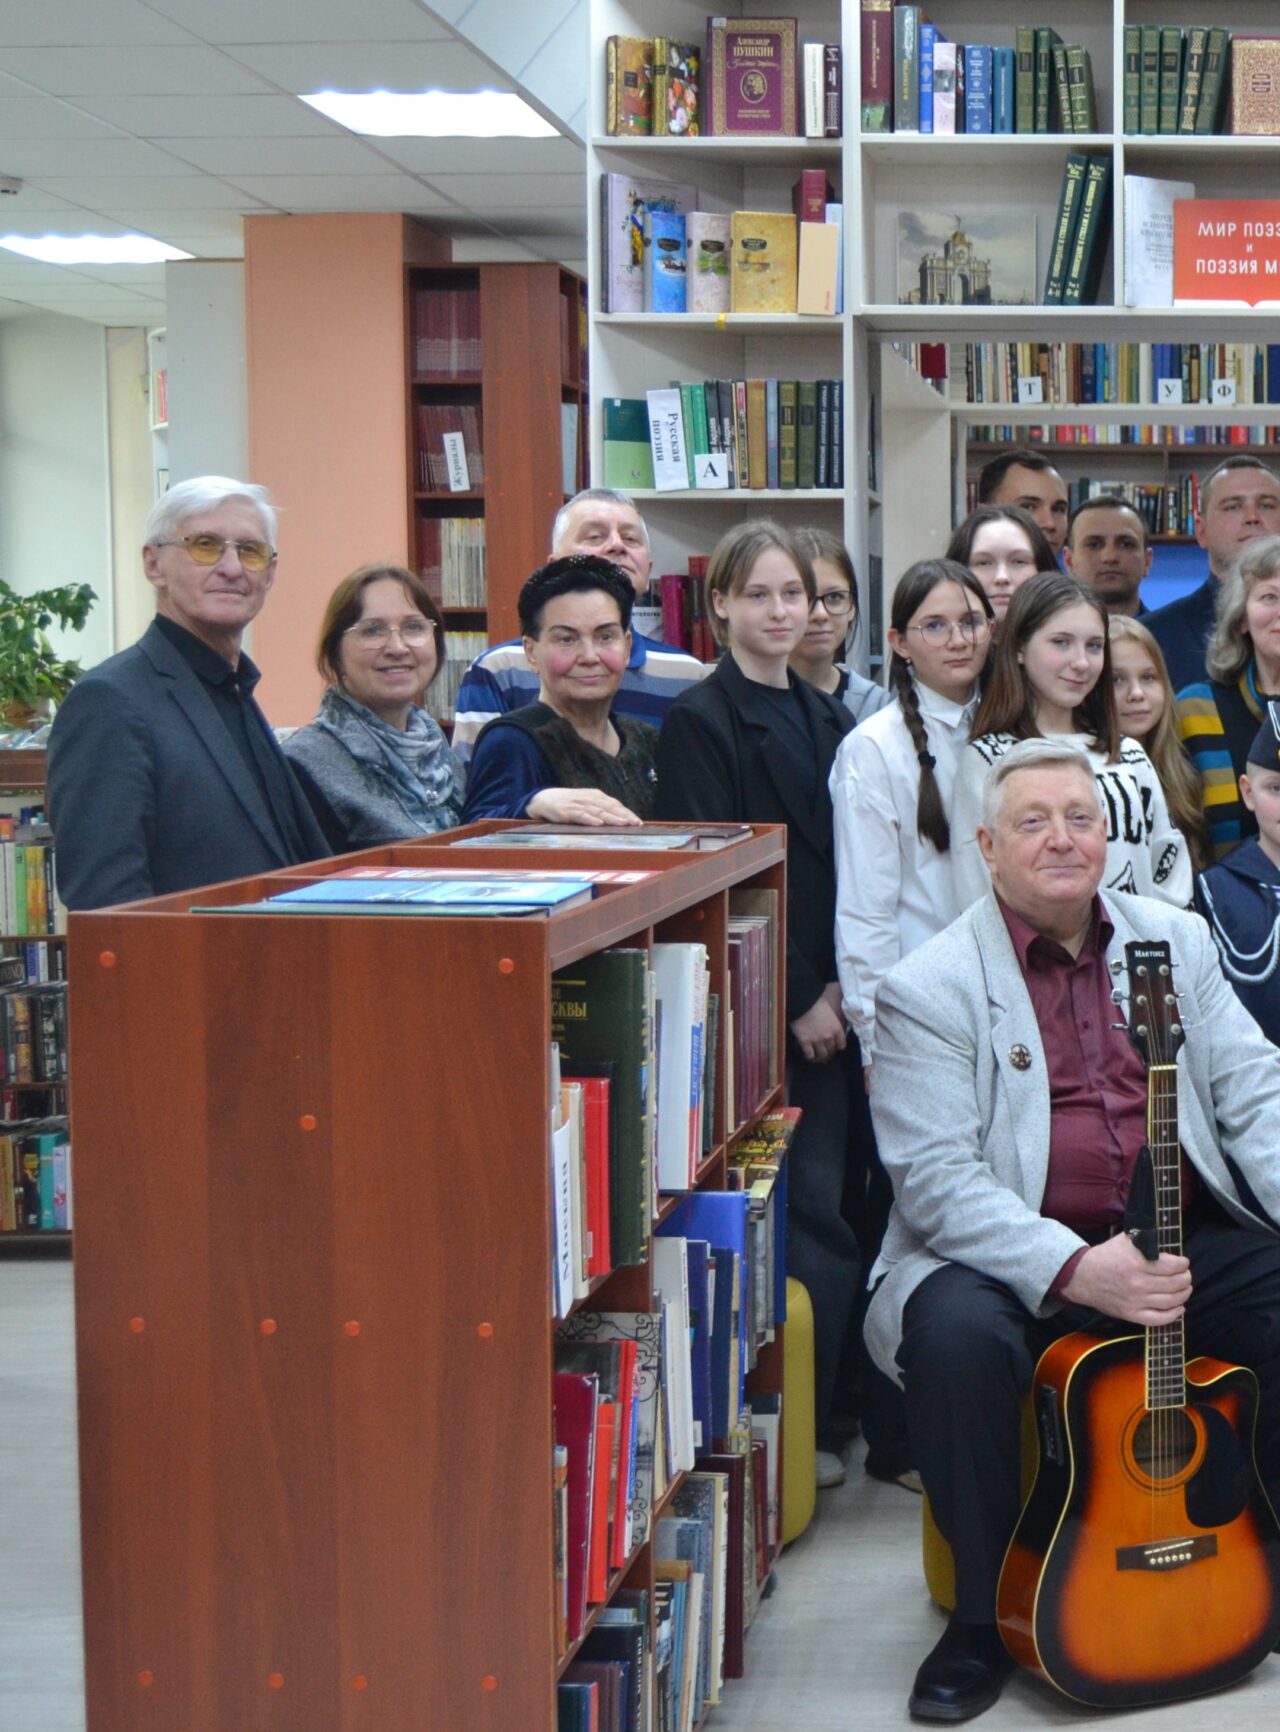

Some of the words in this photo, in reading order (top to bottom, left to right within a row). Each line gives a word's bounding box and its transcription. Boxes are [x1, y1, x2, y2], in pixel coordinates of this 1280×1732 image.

[733, 46, 774, 57] ПУШКИН
[1198, 222, 1237, 237] МИР
[1196, 259, 1258, 274] ПОЭЗИЯ
[1024, 382, 1036, 395] Т
[1163, 384, 1175, 397] У
[1217, 384, 1231, 397] Ф
[652, 420, 664, 462] поэзия
[668, 412, 681, 463] Русская
[449, 438, 466, 488] Журналы
[703, 461, 719, 478] А
[562, 1161, 570, 1281] Москва
